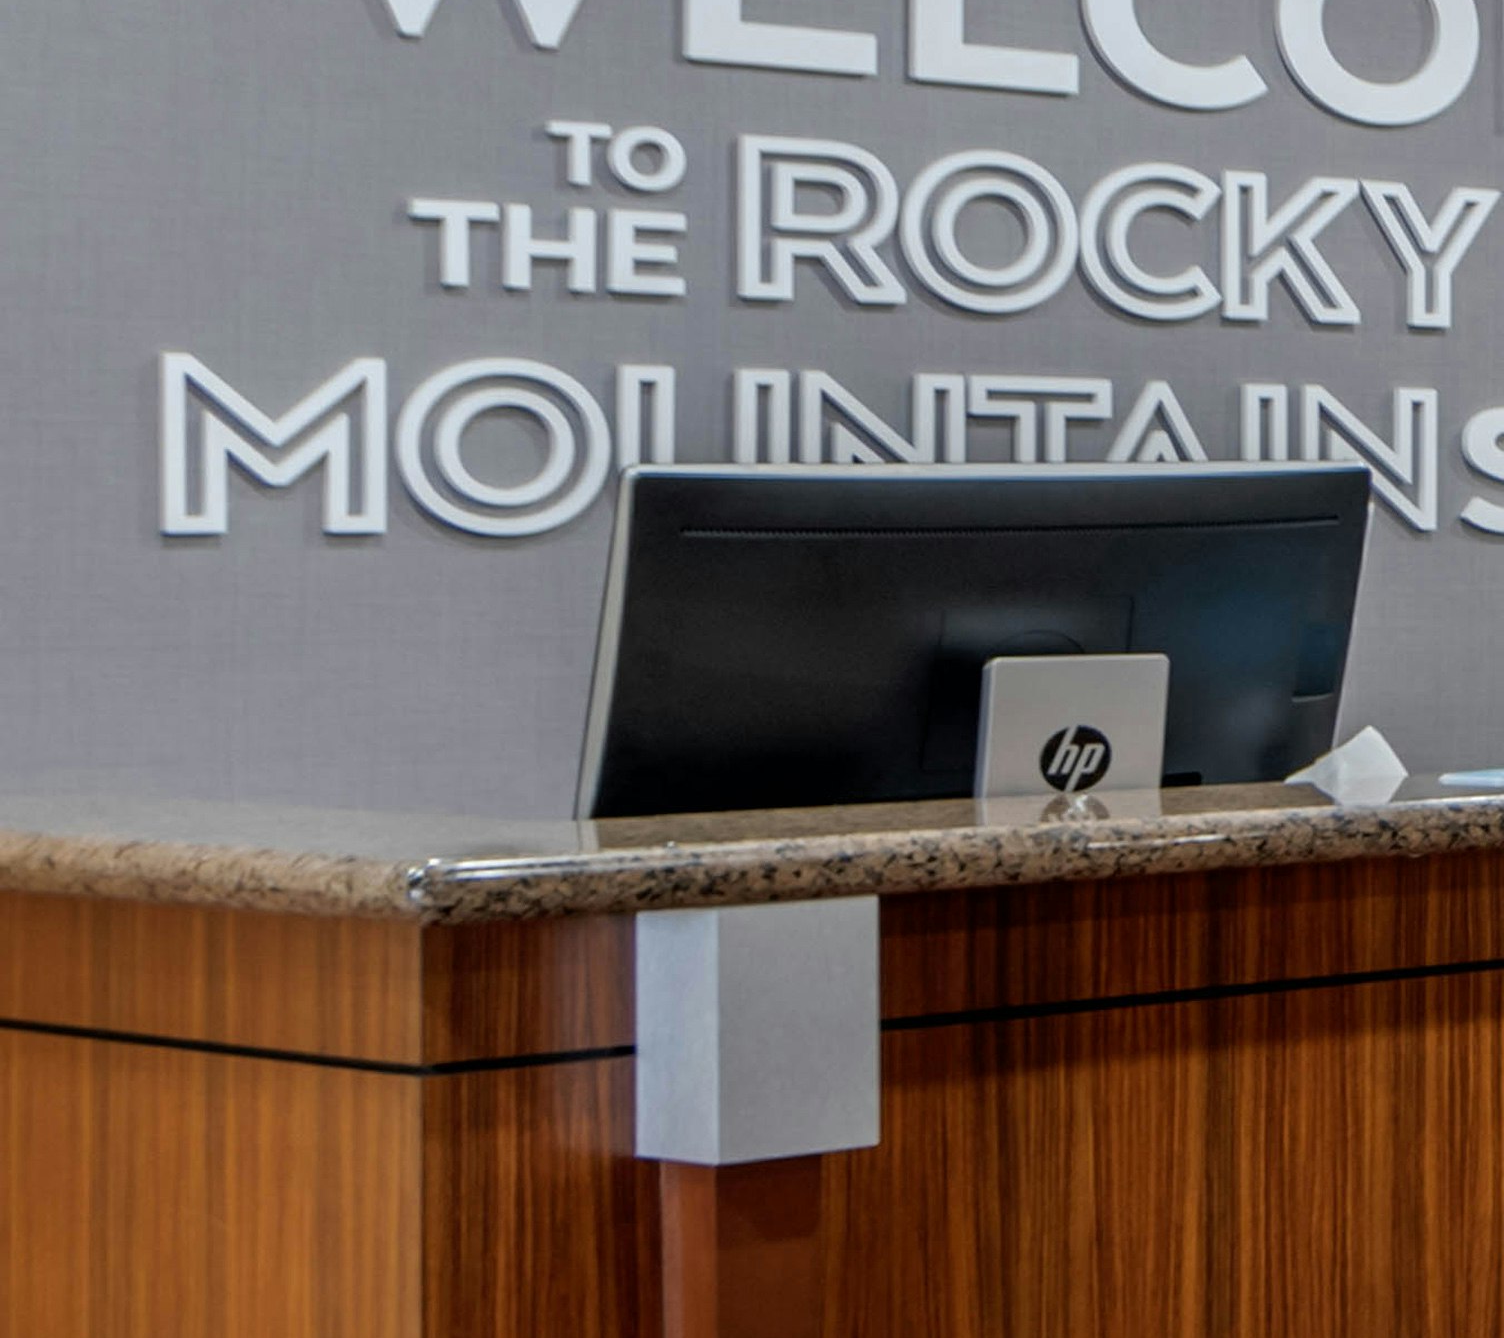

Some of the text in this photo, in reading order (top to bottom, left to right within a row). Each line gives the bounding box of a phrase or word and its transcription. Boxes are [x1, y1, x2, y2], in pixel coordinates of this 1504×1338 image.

[546, 121, 686, 192] TO
[407, 133, 1500, 329] THE ROCKY
[1043, 724, 1107, 792] hp
